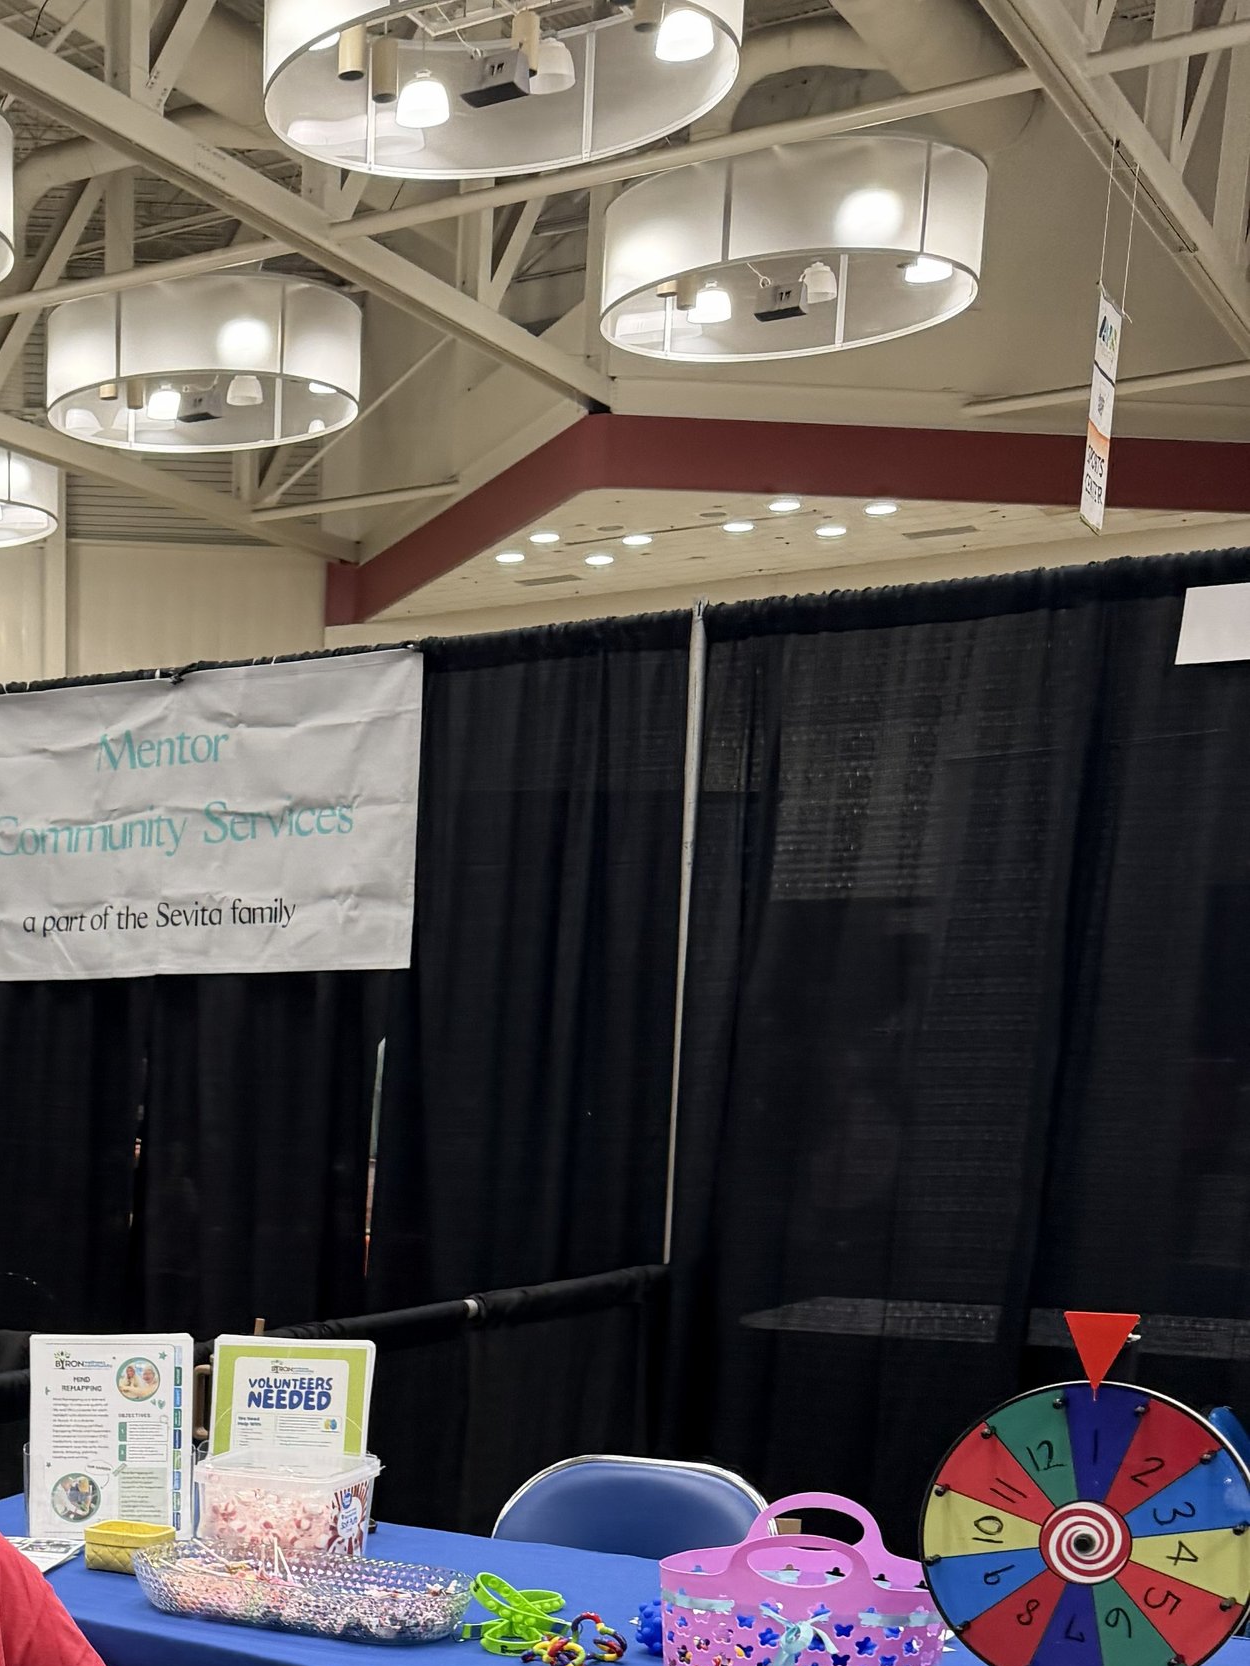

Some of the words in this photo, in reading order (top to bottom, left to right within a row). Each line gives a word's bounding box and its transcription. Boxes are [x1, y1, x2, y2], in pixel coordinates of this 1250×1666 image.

[96, 730, 230, 774] Mentor
[203, 795, 354, 845] Services
[23, 916, 37, 933] a
[42, 911, 86, 938] part
[89, 904, 110, 931] of
[116, 907, 149, 930] the
[155, 902, 223, 928] Sevita
[230, 898, 297, 929] family
[248, 1377, 334, 1391] VOLUNTEERS
[247, 1388, 332, 1411] NEEDED
[1026, 1439, 1066, 1472] 12
[1093, 1428, 1099, 1465] 1
[1129, 1456, 1166, 1489] 2
[989, 1477, 1027, 1504] 11
[1152, 1500, 1196, 1526] 3
[972, 1514, 1004, 1544] 10
[1166, 1540, 1200, 1567] 4
[1016, 1598, 1041, 1627] 8
[1143, 1585, 1183, 1616] 5
[1064, 1617, 1086, 1644] 7
[1104, 1606, 1133, 1639] 6
